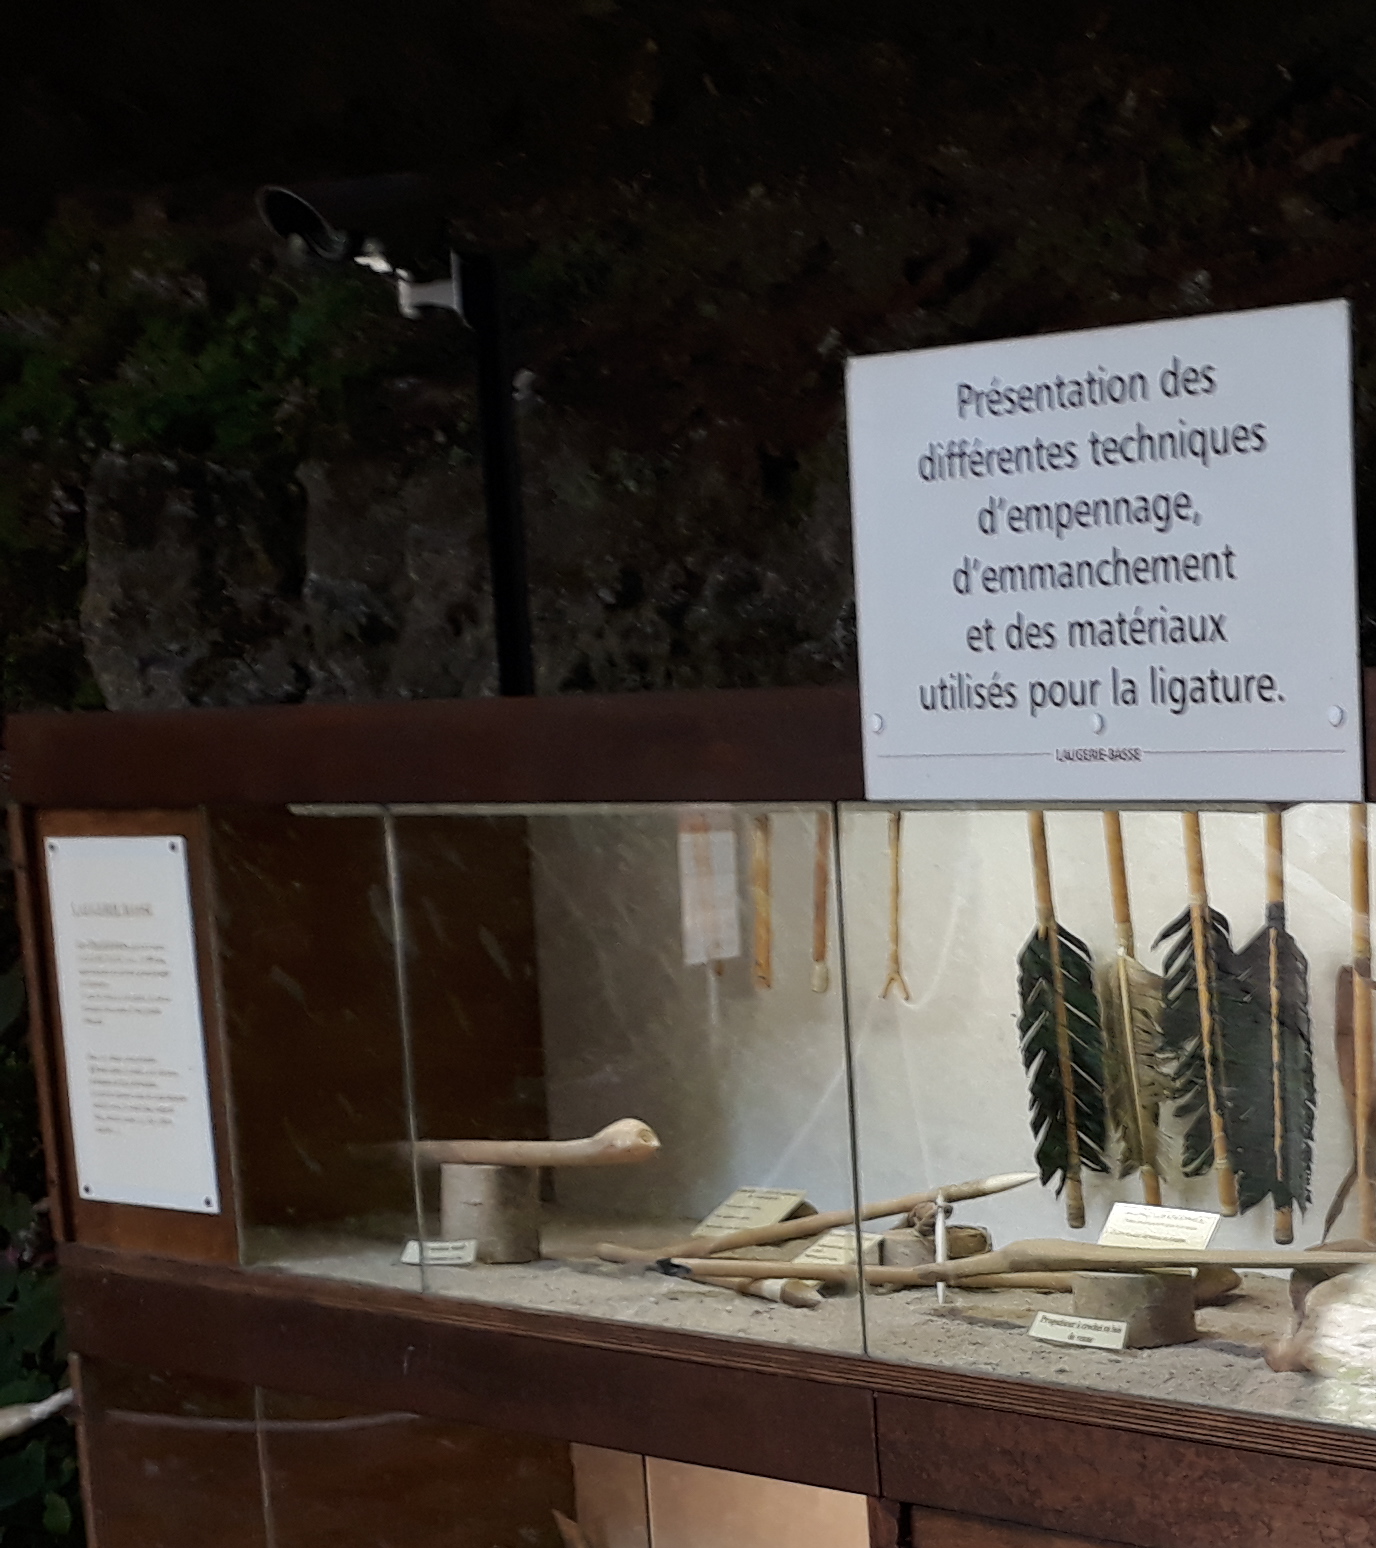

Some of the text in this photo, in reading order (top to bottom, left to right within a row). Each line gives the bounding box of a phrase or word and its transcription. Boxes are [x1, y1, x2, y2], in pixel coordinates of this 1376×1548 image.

[958, 356, 1217, 418] Présentation des
[918, 419, 1267, 482] différentes techniques
[978, 492, 1200, 540] d'empennage,
[953, 544, 1236, 595] d'emmanchement
[967, 605, 1228, 653] et des matériaux
[919, 665, 1285, 717] utilisés pour la ligature.
